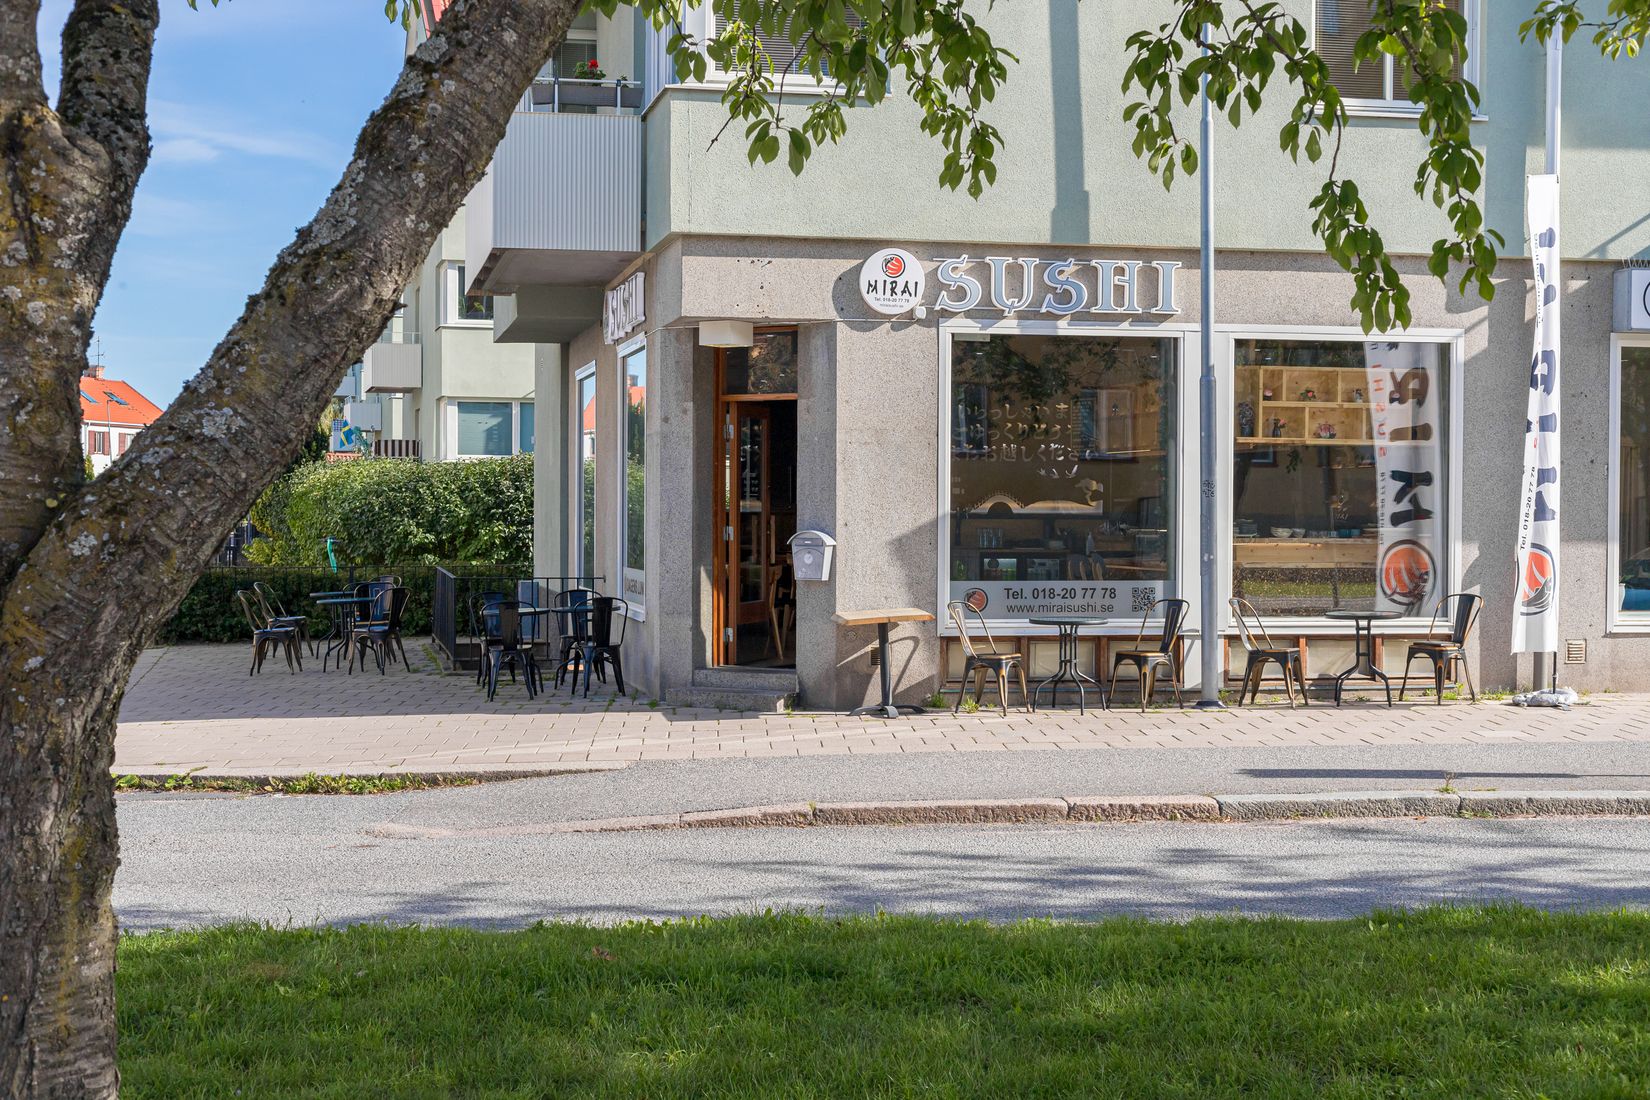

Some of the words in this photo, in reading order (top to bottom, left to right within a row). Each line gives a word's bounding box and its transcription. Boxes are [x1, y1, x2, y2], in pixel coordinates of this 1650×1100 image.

[866, 279, 919, 298] MIRAI
[934, 254, 1182, 316] SUSHI
[1530, 466, 1537, 478] 78
[1527, 481, 1534, 493] 77
[1522, 496, 1532, 531] 018-20
[1004, 588, 1027, 599] Tel.
[1032, 588, 1076, 599] 018-20
[1081, 588, 1096, 599] 77
[1101, 588, 1117, 600] 78
[1006, 602, 1114, 613] www.miraisushi.se
